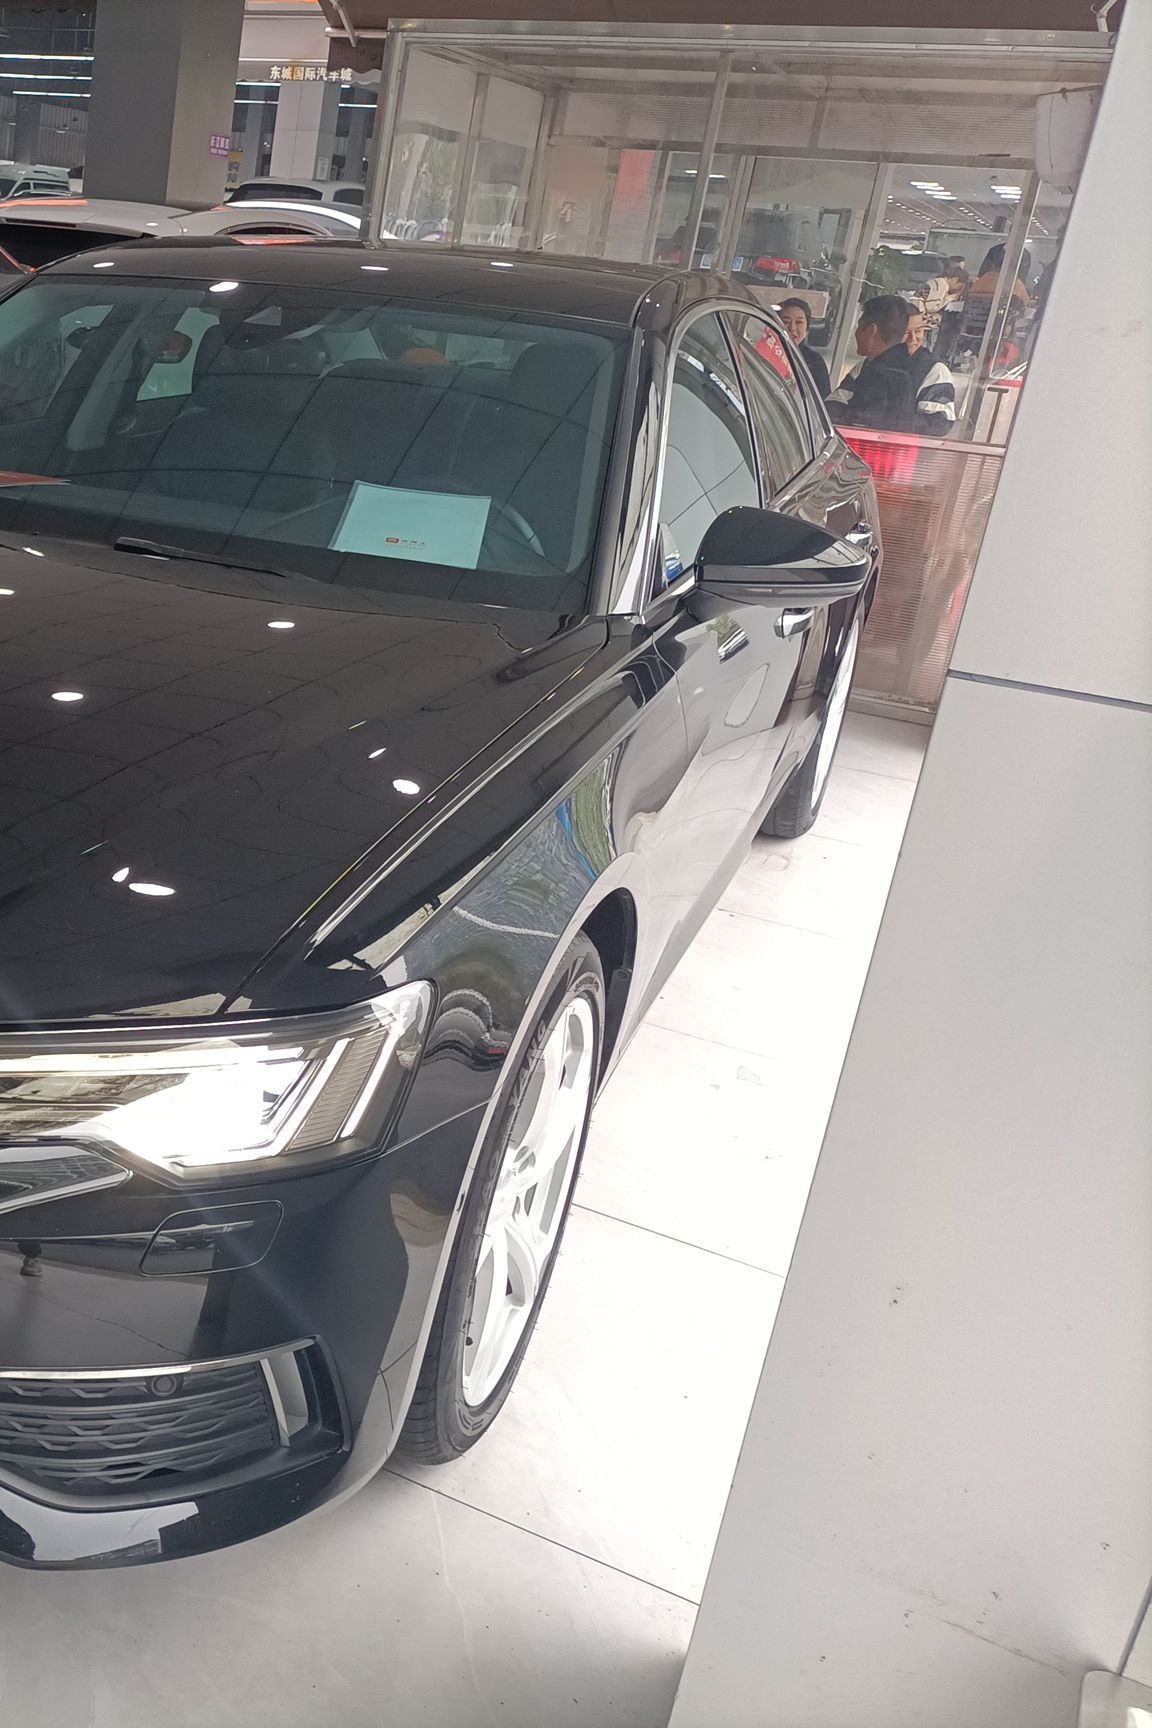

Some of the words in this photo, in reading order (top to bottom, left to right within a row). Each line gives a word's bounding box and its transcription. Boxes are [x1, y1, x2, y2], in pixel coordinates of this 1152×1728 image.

[269, 65, 352, 81] 东城国际汽车城
